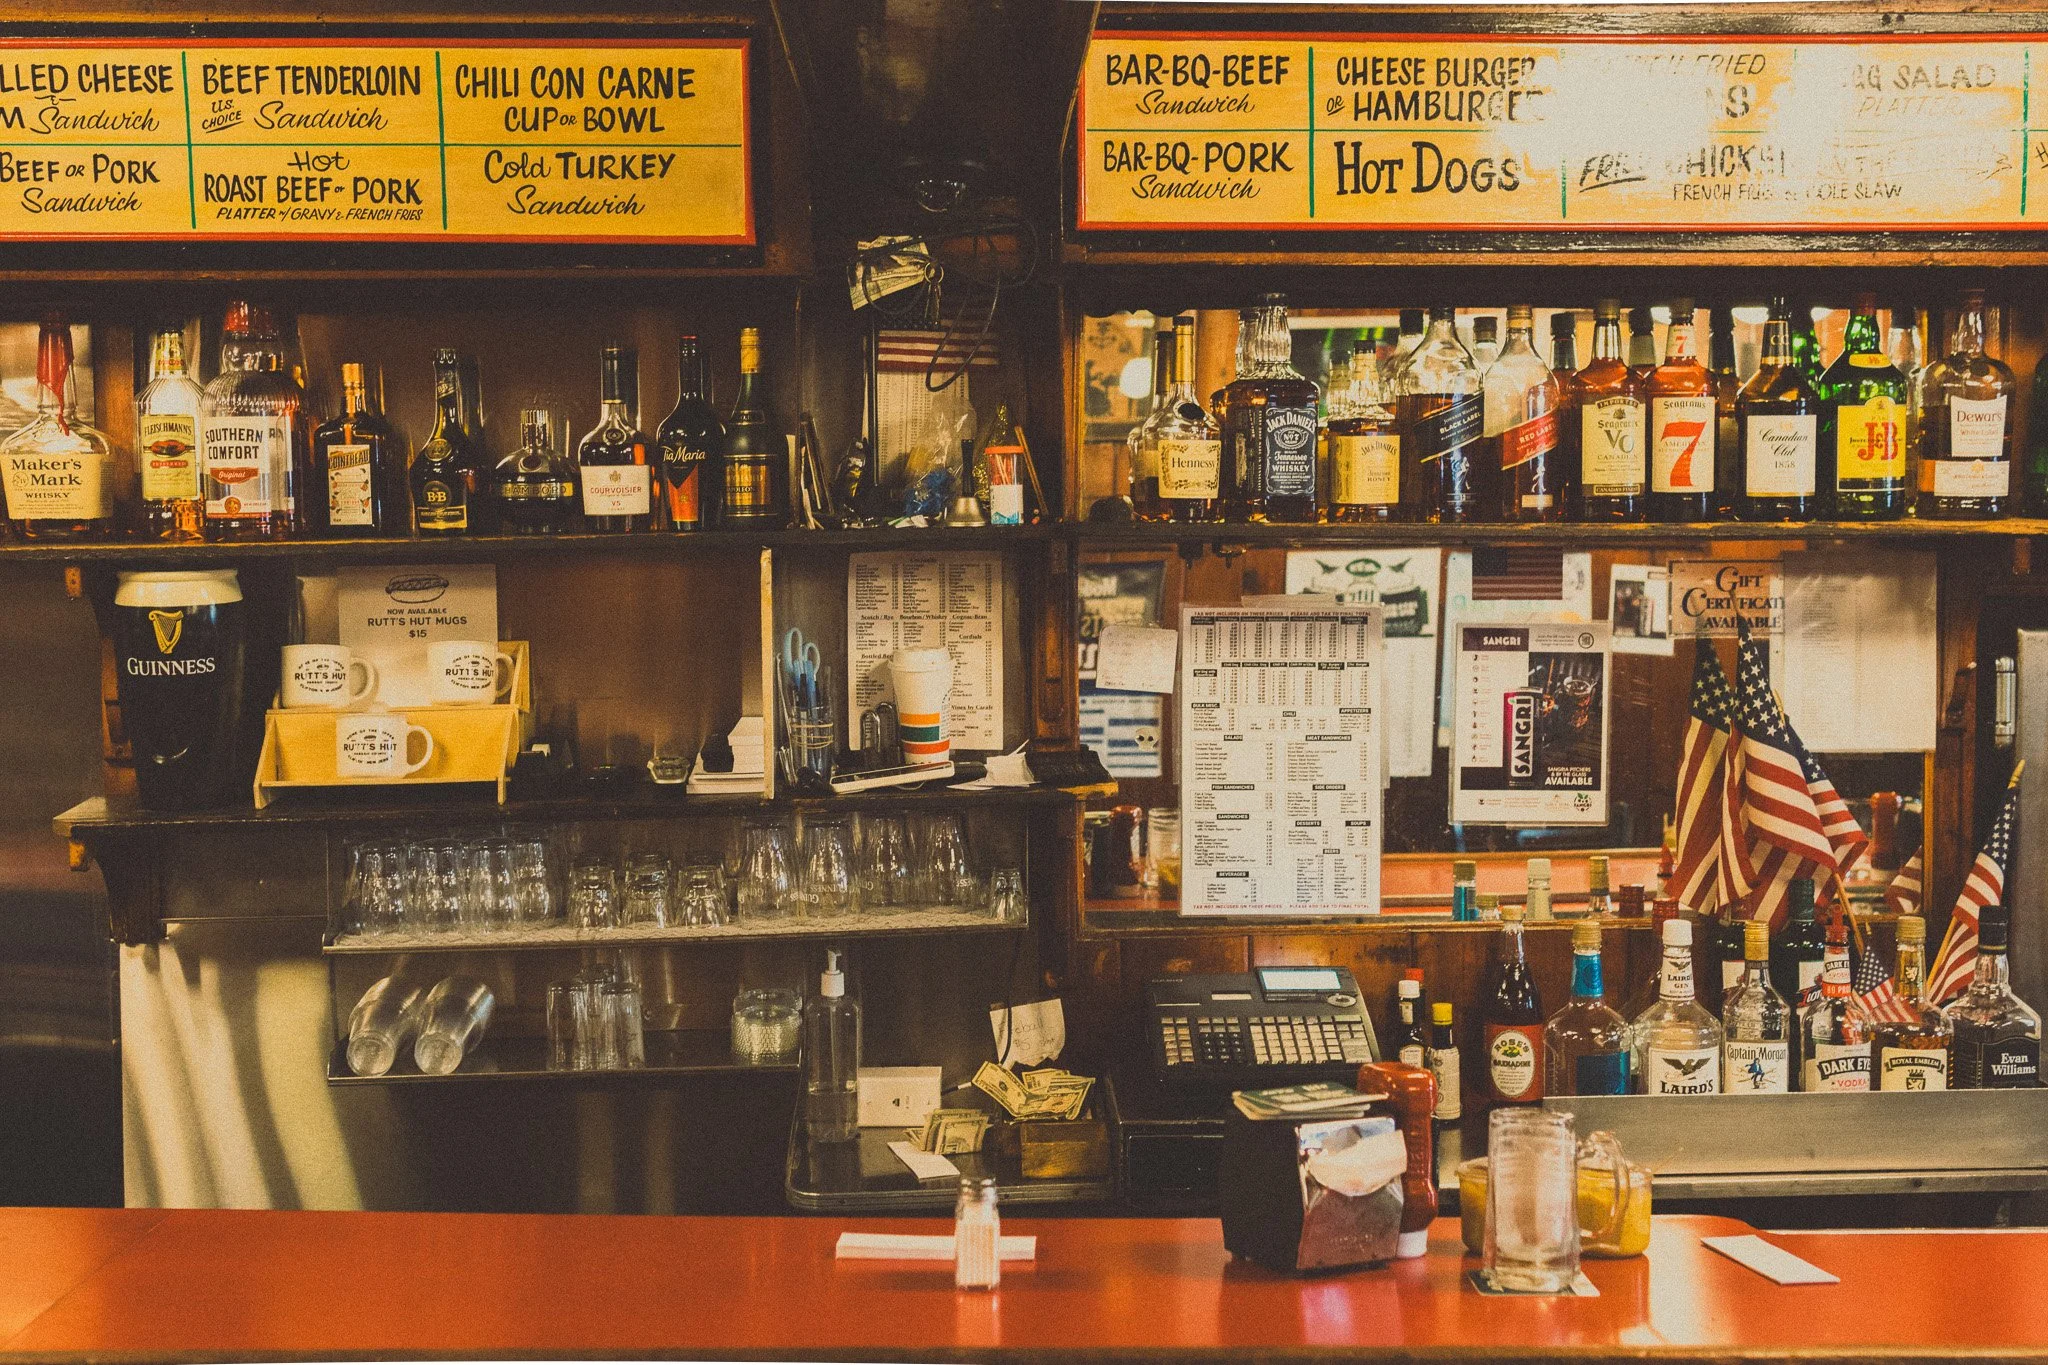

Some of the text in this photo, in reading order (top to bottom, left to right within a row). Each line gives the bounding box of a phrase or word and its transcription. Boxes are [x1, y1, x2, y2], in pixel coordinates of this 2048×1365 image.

[78, 63, 175, 93] CHEESE
[203, 63, 421, 96] BEEF TENDERLOIN
[1106, 53, 1290, 88] BAR-BQ-BEEF
[1336, 56, 1426, 87] CHEESE
[1893, 64, 1997, 90] SALAD
[455, 63, 697, 99] CHILI CON CARNE
[1135, 90, 1256, 115] Sandwich
[30, 106, 160, 135] Sandwich
[201, 109, 243, 129] CHOICE
[253, 100, 389, 131] Sandwich
[504, 105, 559, 132] CUP
[583, 106, 666, 133] BOWL
[0, 151, 60, 183] BEEF
[93, 153, 161, 184] PORK
[287, 150, 351, 172] Hot
[484, 149, 677, 184] Cold TURKEY
[204, 174, 268, 203] ROAST
[277, 176, 331, 203] BEEF
[353, 177, 423, 204] PORK
[1132, 174, 1261, 200] Sandwich
[1673, 182, 1731, 201] FRENCH
[1853, 180, 1903, 200] SLAW
[21, 187, 143, 214] Sandwich
[507, 184, 646, 216] Sandwich
[216, 206, 276, 220] PLATTER
[291, 207, 335, 221] GRAVY
[346, 207, 394, 221] FRENCH
[394, 207, 424, 221] FRIES
[1675, 335, 1689, 353] 7
[1266, 411, 1317, 435] JACK DANIEL'S
[1440, 412, 1482, 435] BLACK LABEL
[205, 427, 264, 443] SOUTHERN
[1519, 431, 1535, 444] RED
[1759, 427, 1809, 443] Canadian
[208, 446, 260, 460] COMFORT
[662, 446, 707, 463] Tia Maria
[1661, 420, 1707, 487] 7
[1771, 443, 1797, 457] Club
[12, 458, 82, 471] Maker's
[1271, 464, 1310, 472] WHISKEY
[31, 474, 82, 486] Mark
[218, 471, 247, 481] Original
[590, 486, 643, 495] COURVOISIER
[1716, 566, 1763, 592] GIFT
[407, 607, 447, 615] AVAILABLE
[1682, 587, 1784, 617] CERTFICAT
[367, 615, 468, 627] RUTT'S HUT MUGS
[1703, 616, 1780, 629] AVAIABLE
[408, 628, 428, 639] $15
[1483, 636, 1521, 646] SANGRI
[127, 657, 216, 676] GUINNESS
[482, 668, 494, 678] HUT
[332, 671, 347, 681] HUT
[1514, 698, 1532, 774] SANGRI
[379, 742, 398, 751] HUT
[1545, 777, 1593, 786] AVAILABLE
[1494, 1038, 1530, 1053] ROSE'S
[1726, 1043, 1757, 1061] Captain
[1821, 1057, 1871, 1076] DARK EYE
[1892, 1058, 1940, 1067] ROYAL EMBLEM
[2001, 1052, 2029, 1064] Evan
[1991, 1064, 2037, 1076] Williams
[1660, 1080, 1714, 1094] LAIRD'S
